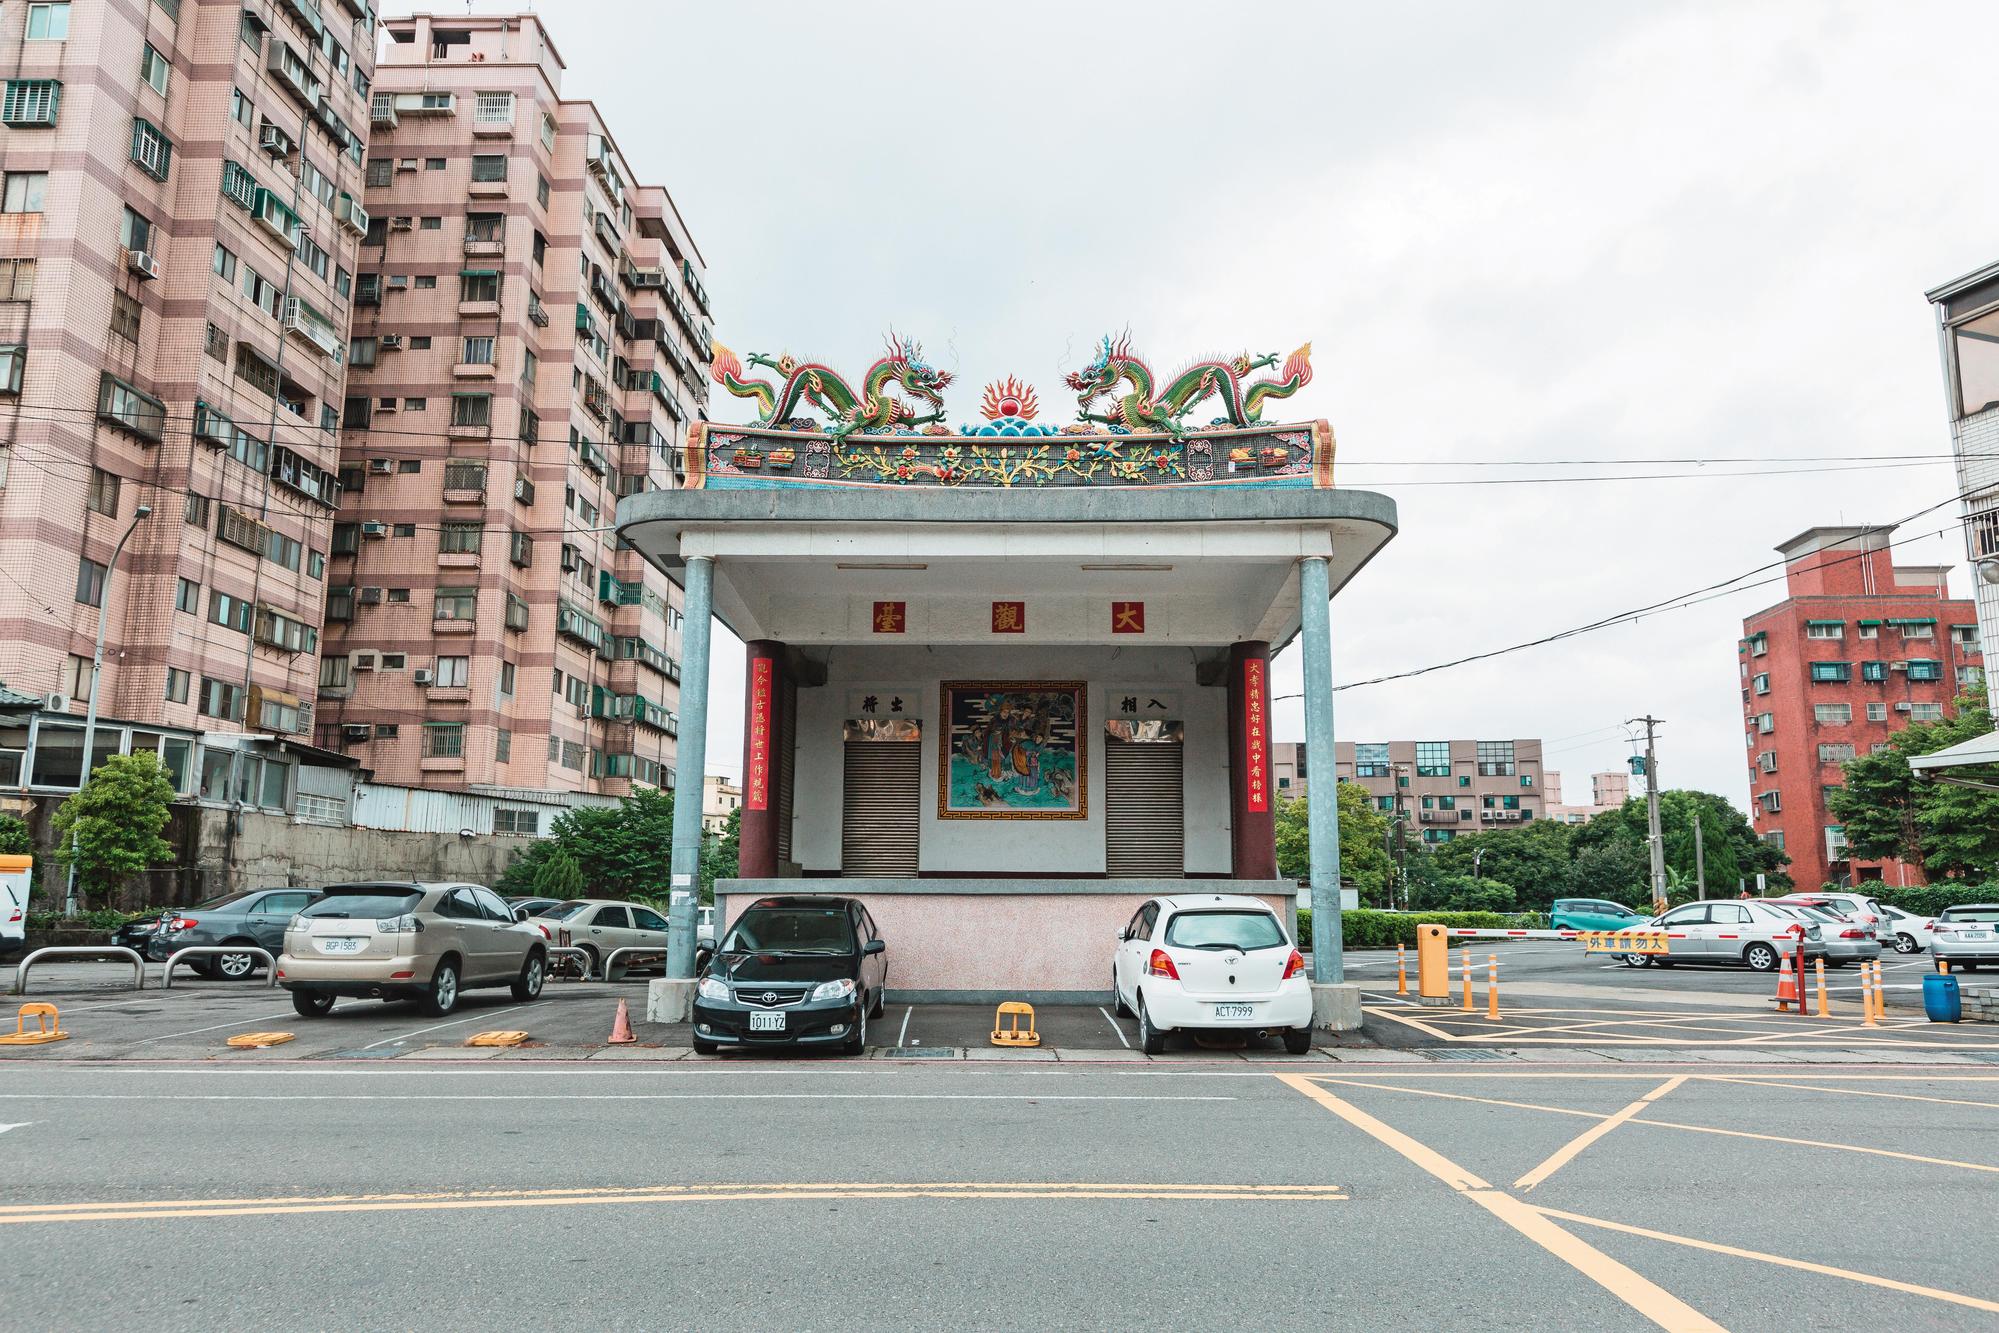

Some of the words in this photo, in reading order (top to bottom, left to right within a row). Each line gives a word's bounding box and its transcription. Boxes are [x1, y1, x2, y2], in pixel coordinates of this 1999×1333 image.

[1590, 937, 1662, 950] 外車請勿入
[1215, 1006, 1253, 1017] ACT-7999
[752, 1016, 785, 1028] 1011-YZ
